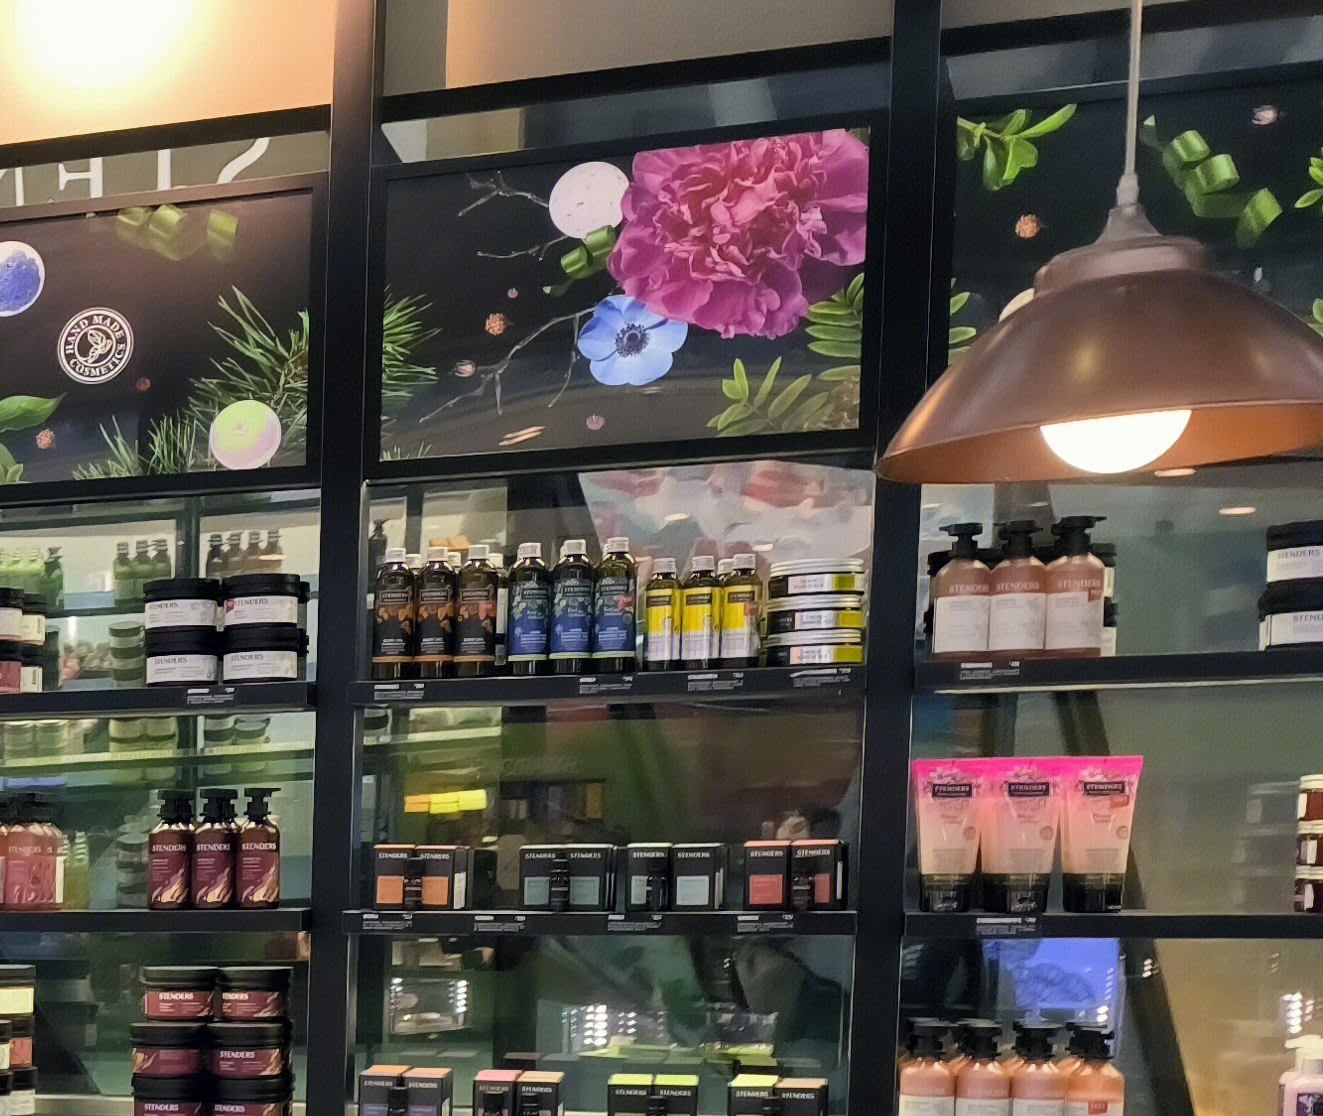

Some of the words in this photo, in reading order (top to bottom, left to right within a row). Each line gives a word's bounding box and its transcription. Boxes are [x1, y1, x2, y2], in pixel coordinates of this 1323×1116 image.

[66, 319, 89, 354] HAND
[92, 315, 124, 339] MADE
[69, 343, 125, 377] COSMETICS
[949, 584, 990, 593] STENDER
[1293, 614, 1323, 623] STEND
[241, 842, 277, 851] STENDERS
